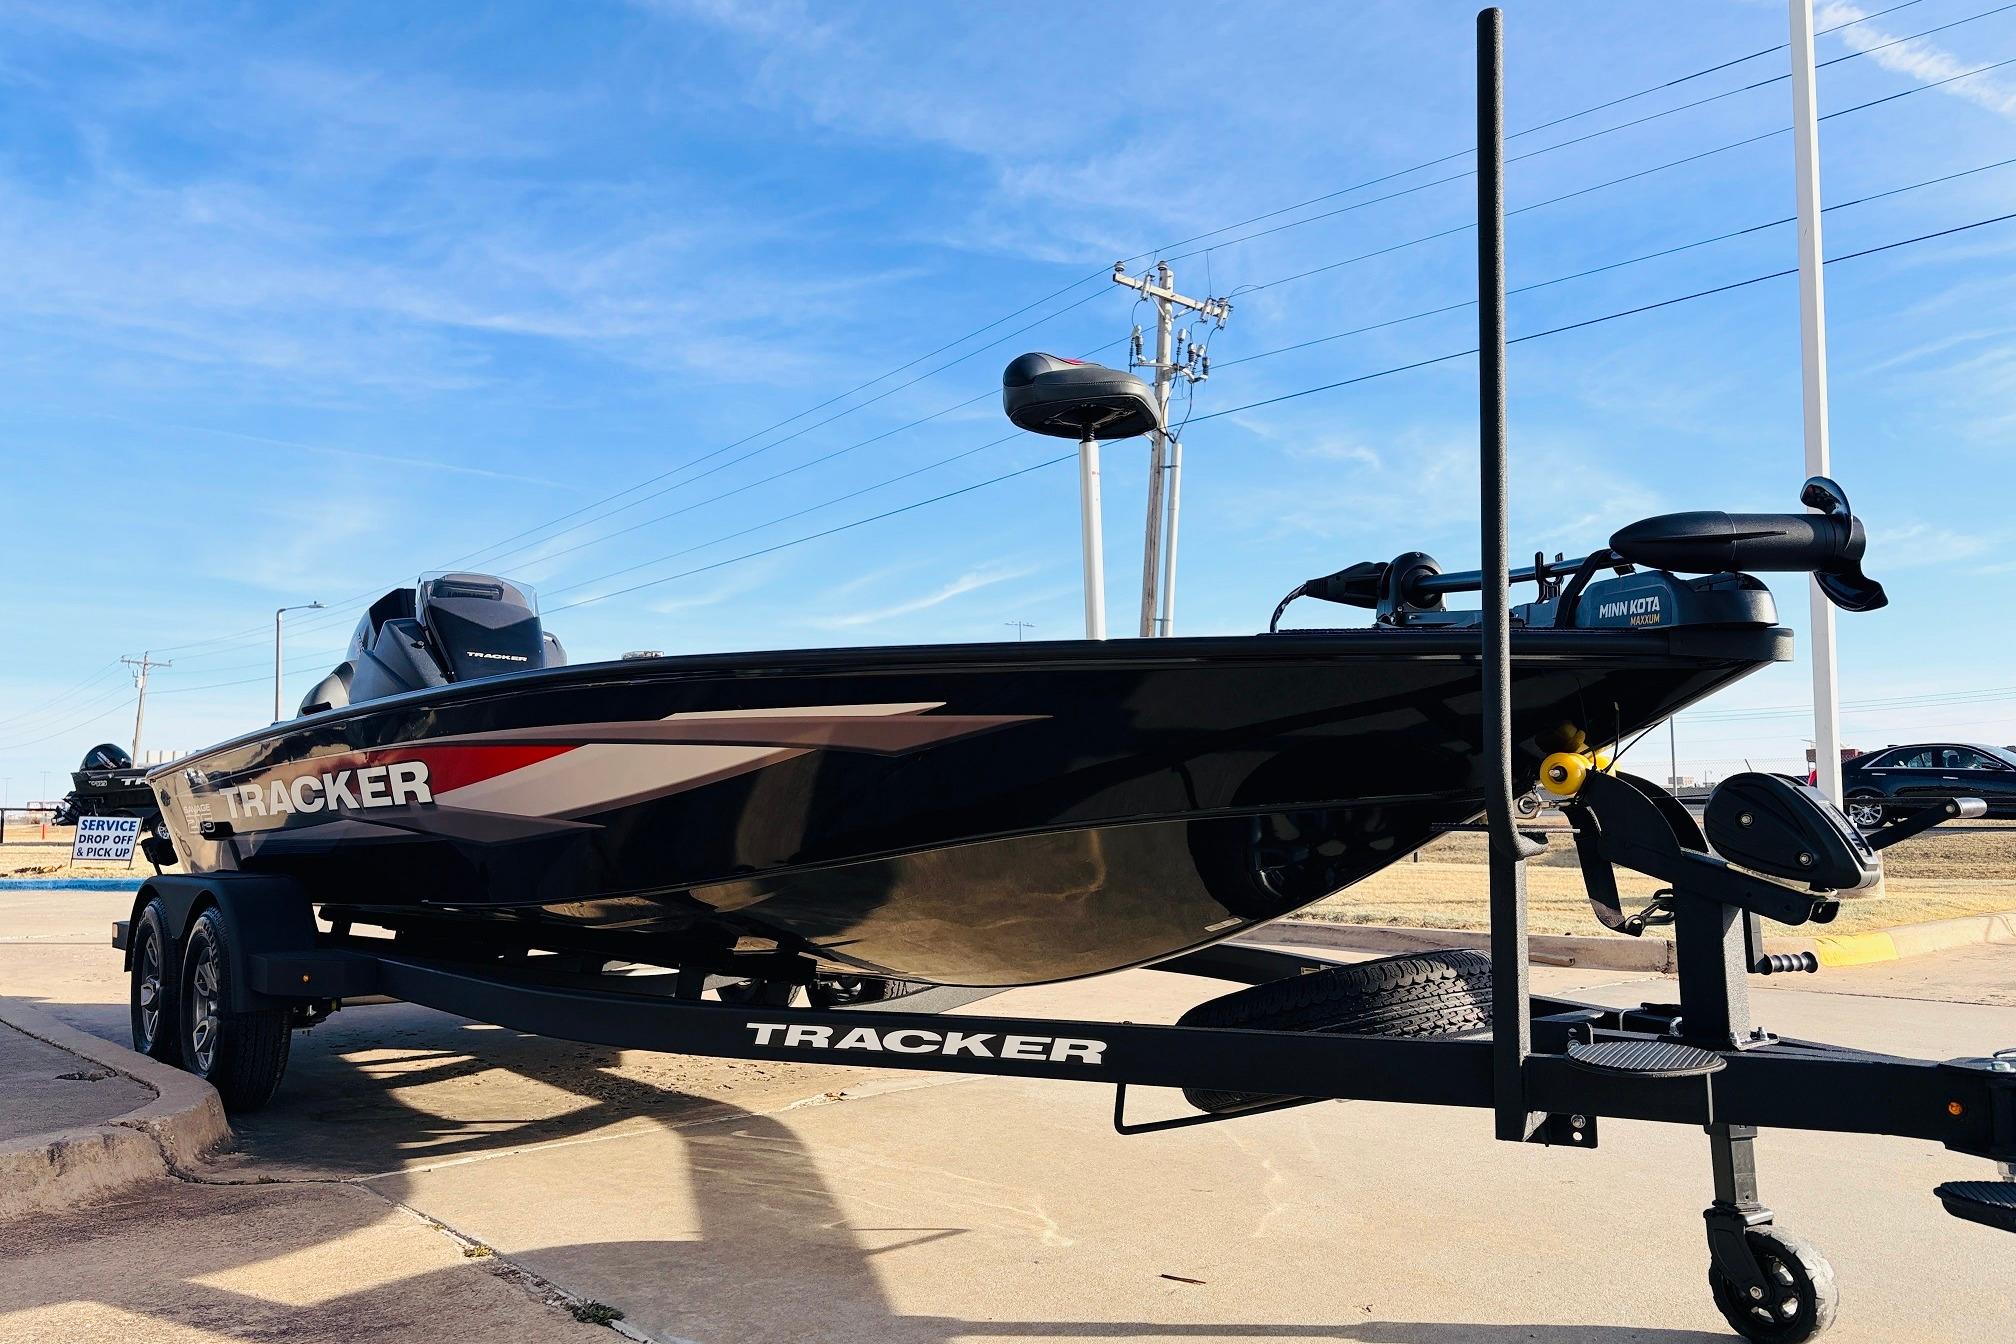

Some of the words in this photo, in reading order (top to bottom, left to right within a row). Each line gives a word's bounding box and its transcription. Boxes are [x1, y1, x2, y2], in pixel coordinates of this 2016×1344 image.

[1599, 601, 1628, 619] MINN
[1629, 596, 1660, 615] KOTA
[1630, 614, 1660, 626] MAXXUM
[466, 651, 528, 661] TRACKER
[219, 761, 433, 819] TRACKER
[81, 819, 137, 832] SERVICE
[78, 834, 110, 844] DROP
[113, 835, 133, 845] OFF
[76, 847, 84, 857] &
[86, 847, 112, 857] PICK
[115, 848, 130, 857] UP
[746, 1022, 1107, 1066] TRACKER
